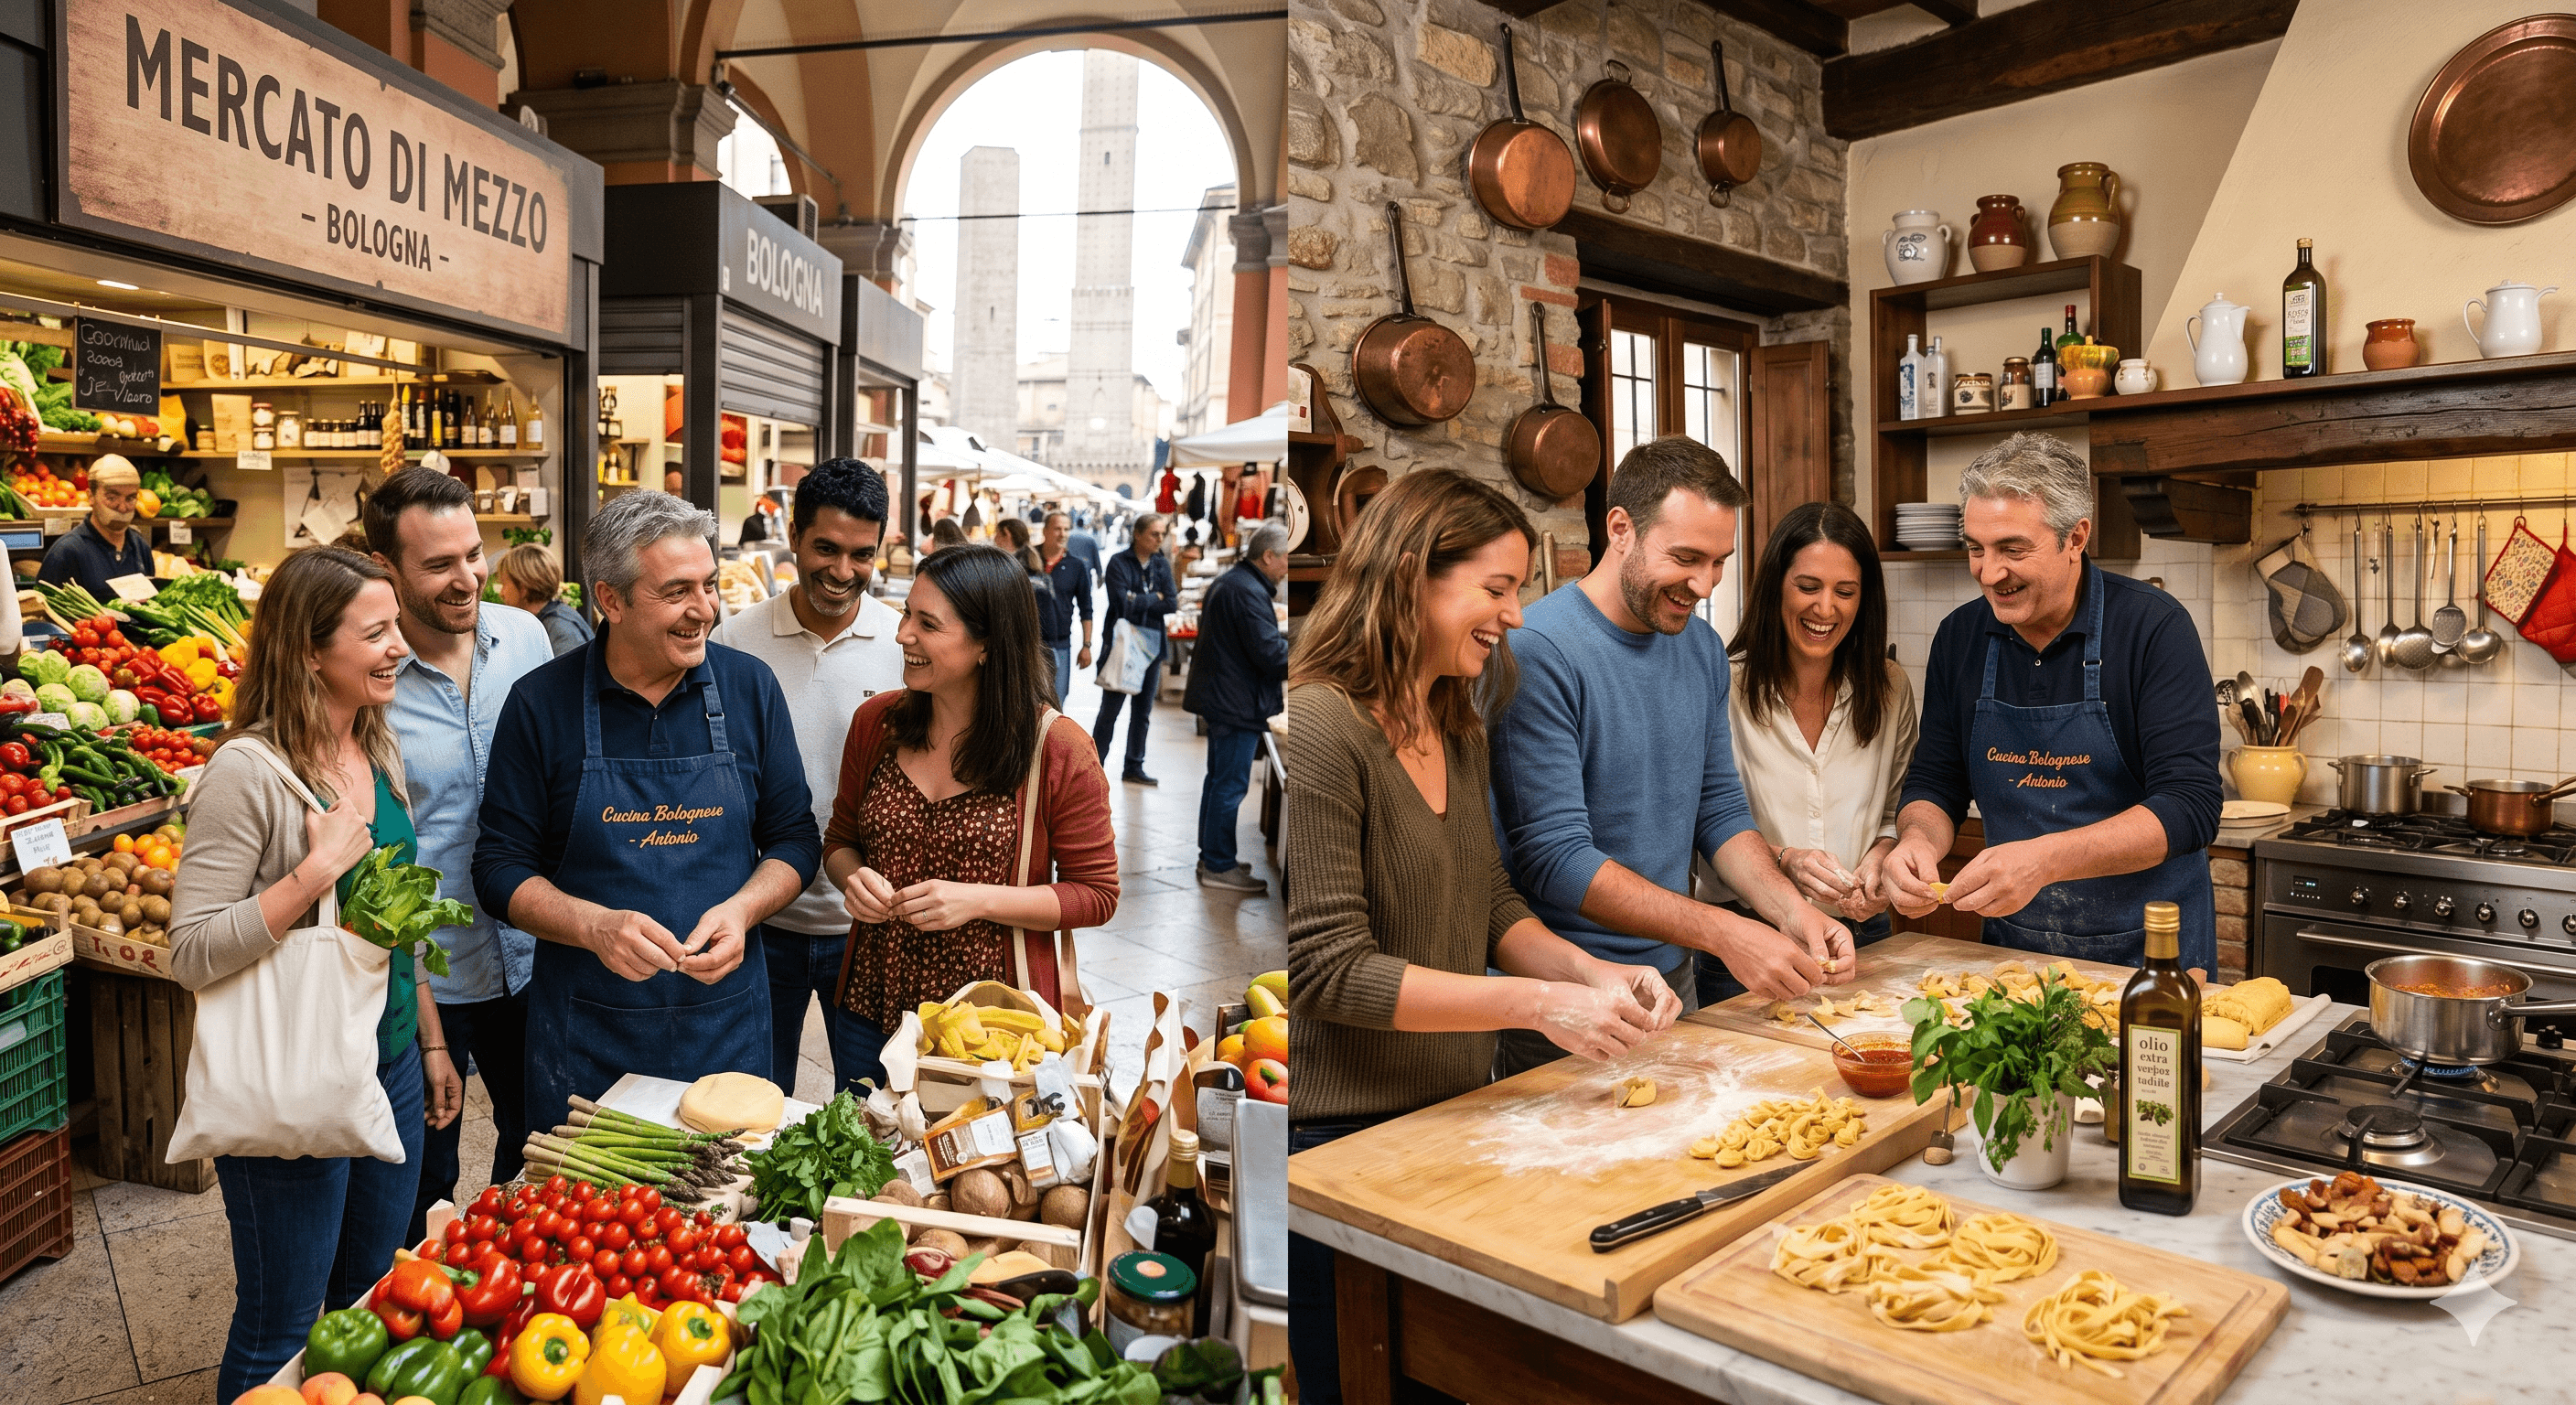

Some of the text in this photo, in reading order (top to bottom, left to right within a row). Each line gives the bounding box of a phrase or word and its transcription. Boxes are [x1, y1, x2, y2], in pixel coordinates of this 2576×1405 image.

[125, 13, 548, 255] MERCATO DI MEZZO
[327, 202, 432, 273] BOLOGNA
[746, 228, 824, 318] BOLOGNA
[1987, 746, 2092, 771] Cucina Bolognese
[2016, 772, 2068, 788] Antonio
[602, 803, 724, 825] Cucina Bolognese
[639, 829, 700, 849] Antonio
[2139, 1036, 2169, 1052] olio
[2140, 1053, 2168, 1064] extra
